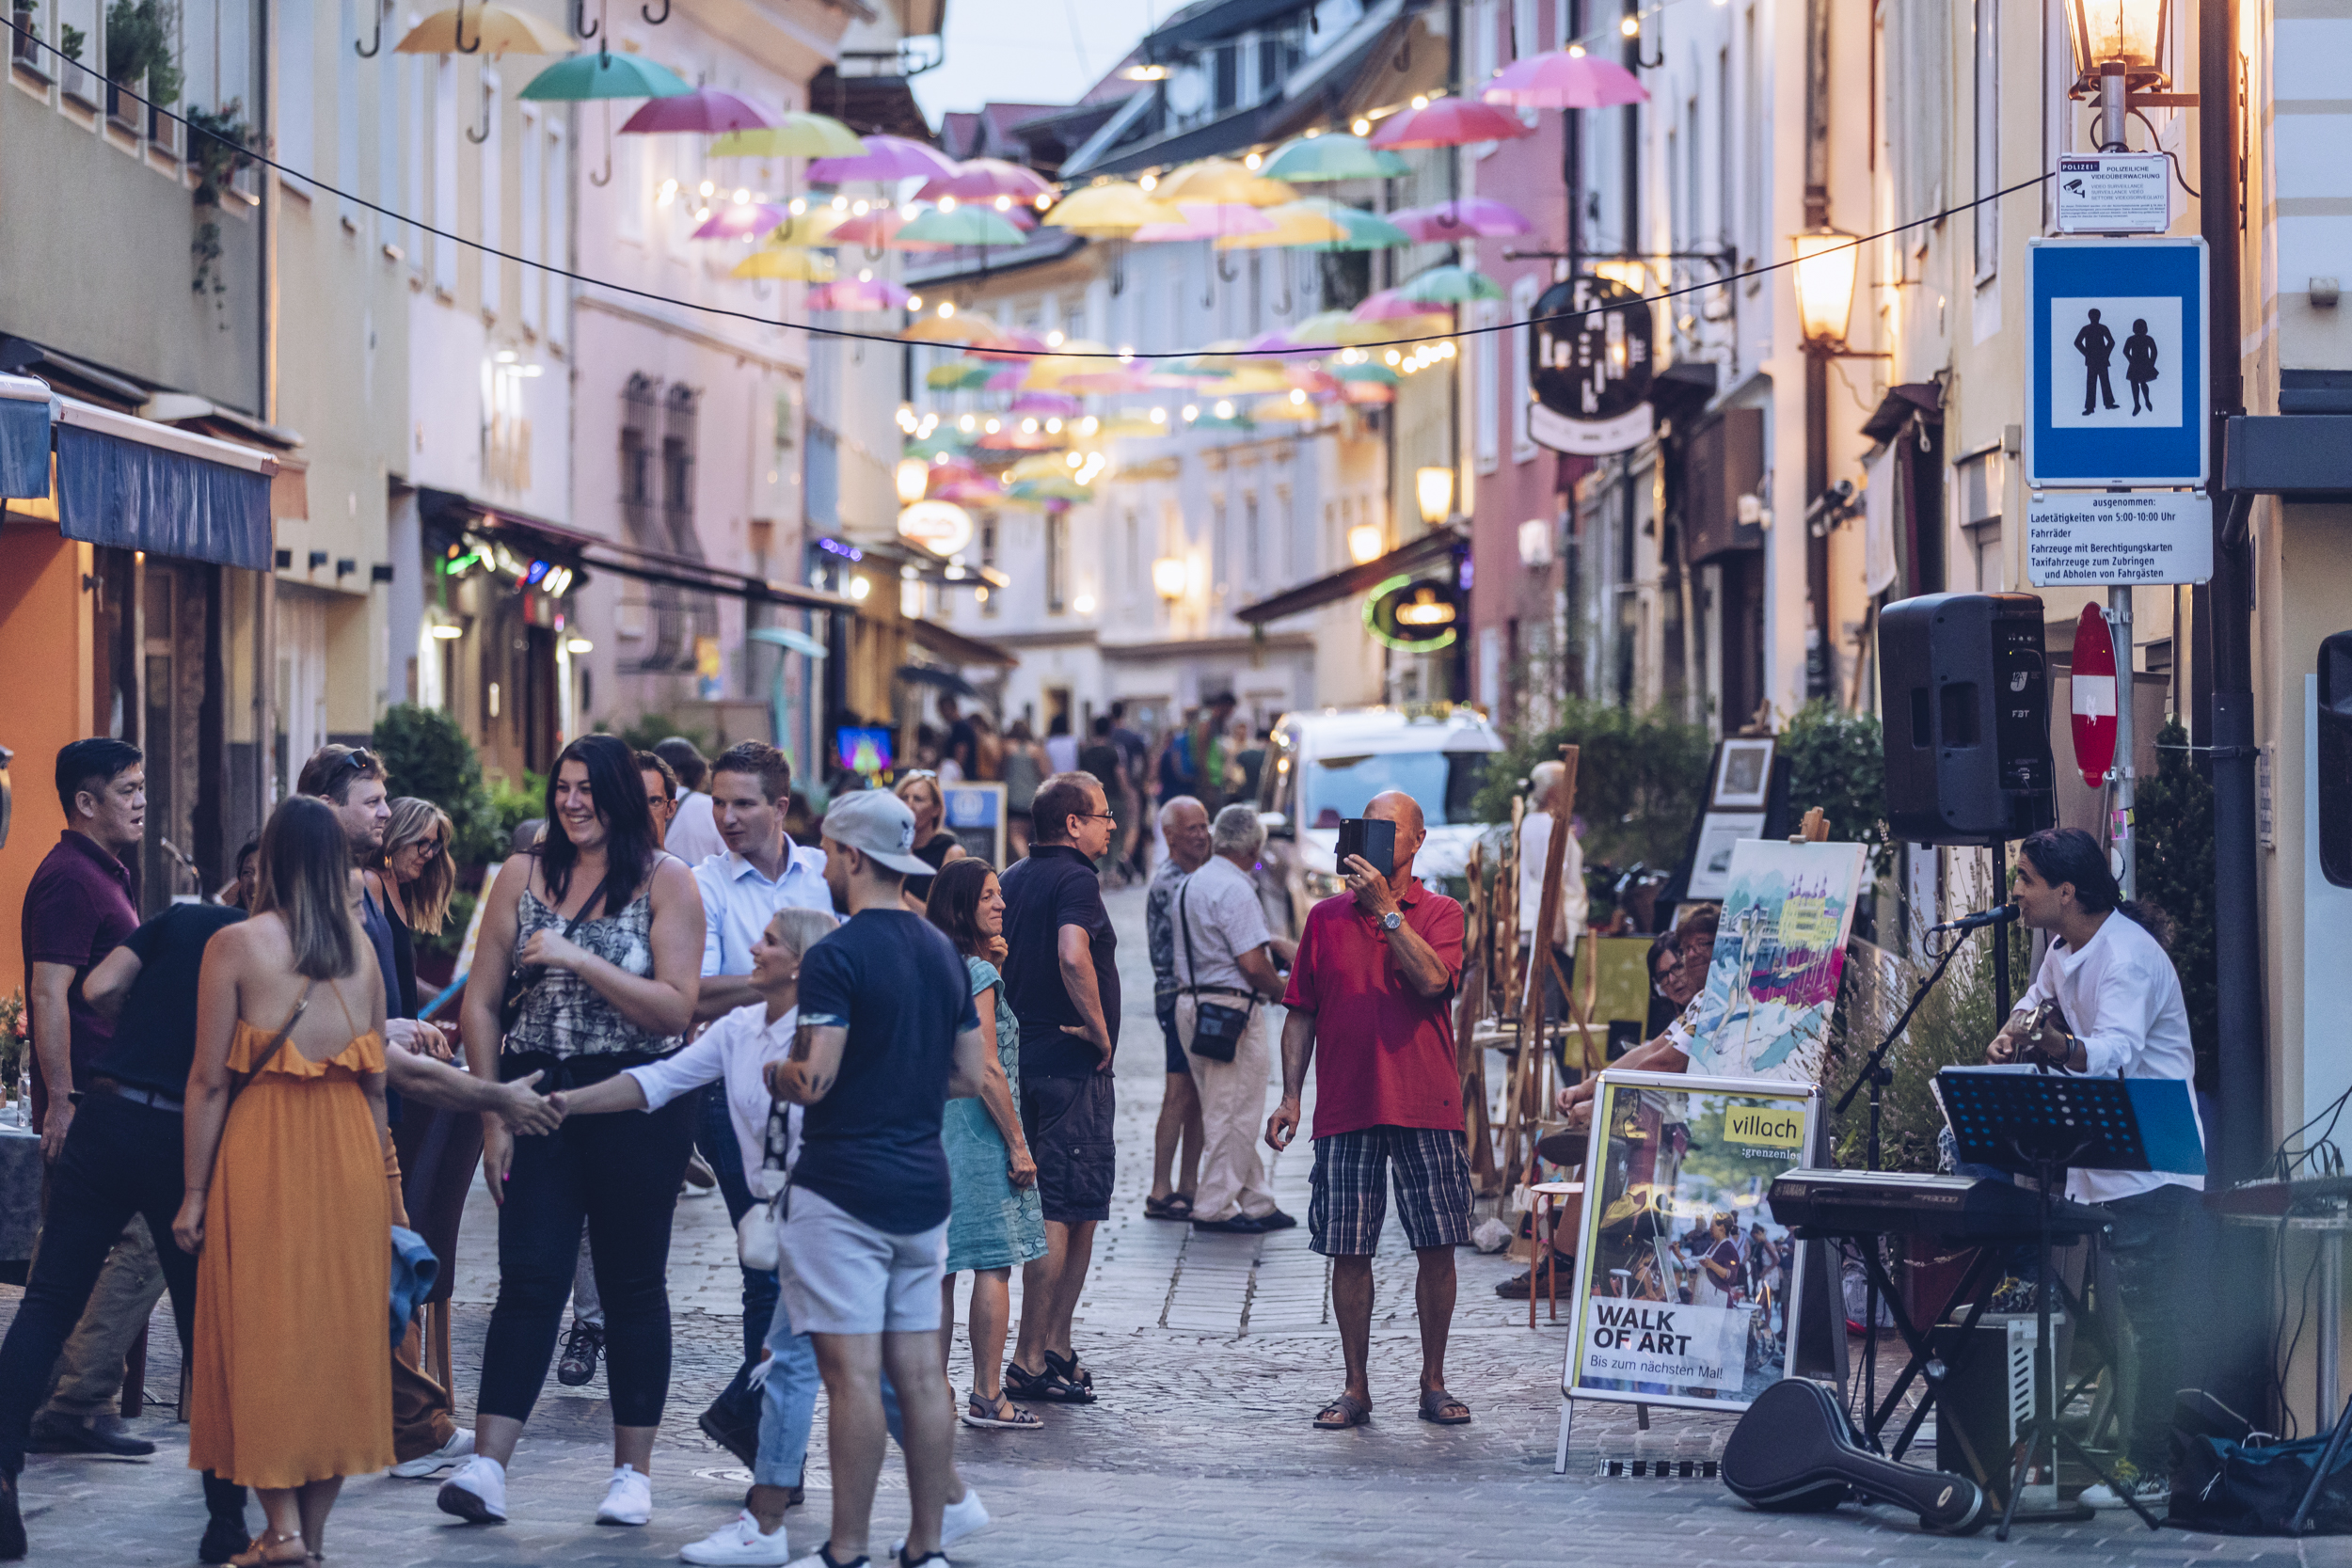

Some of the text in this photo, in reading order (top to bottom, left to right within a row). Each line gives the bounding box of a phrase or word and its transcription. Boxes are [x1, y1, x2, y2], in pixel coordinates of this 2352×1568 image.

[2092, 499, 2156, 508] ausgenommen:
[2030, 513, 2095, 524] Ladetätigkeiten
[2115, 513, 2158, 522] 5:00-10:00
[2161, 512, 2175, 521] Uhr
[2031, 529, 2072, 538] Fahrräder
[2031, 543, 2173, 555] Fahrzeuge mit Berechtigungskarten
[2031, 557, 2090, 568] Taxifahrzeuge
[2112, 556, 2154, 567] Zubringen
[2044, 568, 2164, 580] und Abholen von Fahrgästen
[2011, 709, 2030, 719] FBT
[1732, 1116, 1798, 1139] villach
[1782, 1183, 1807, 1197] YAMAHA
[1597, 1304, 1677, 1332] WALK
[1593, 1327, 1692, 1355] OF ART
[1590, 1354, 1724, 1380] Bis zum nächsten Mal!
